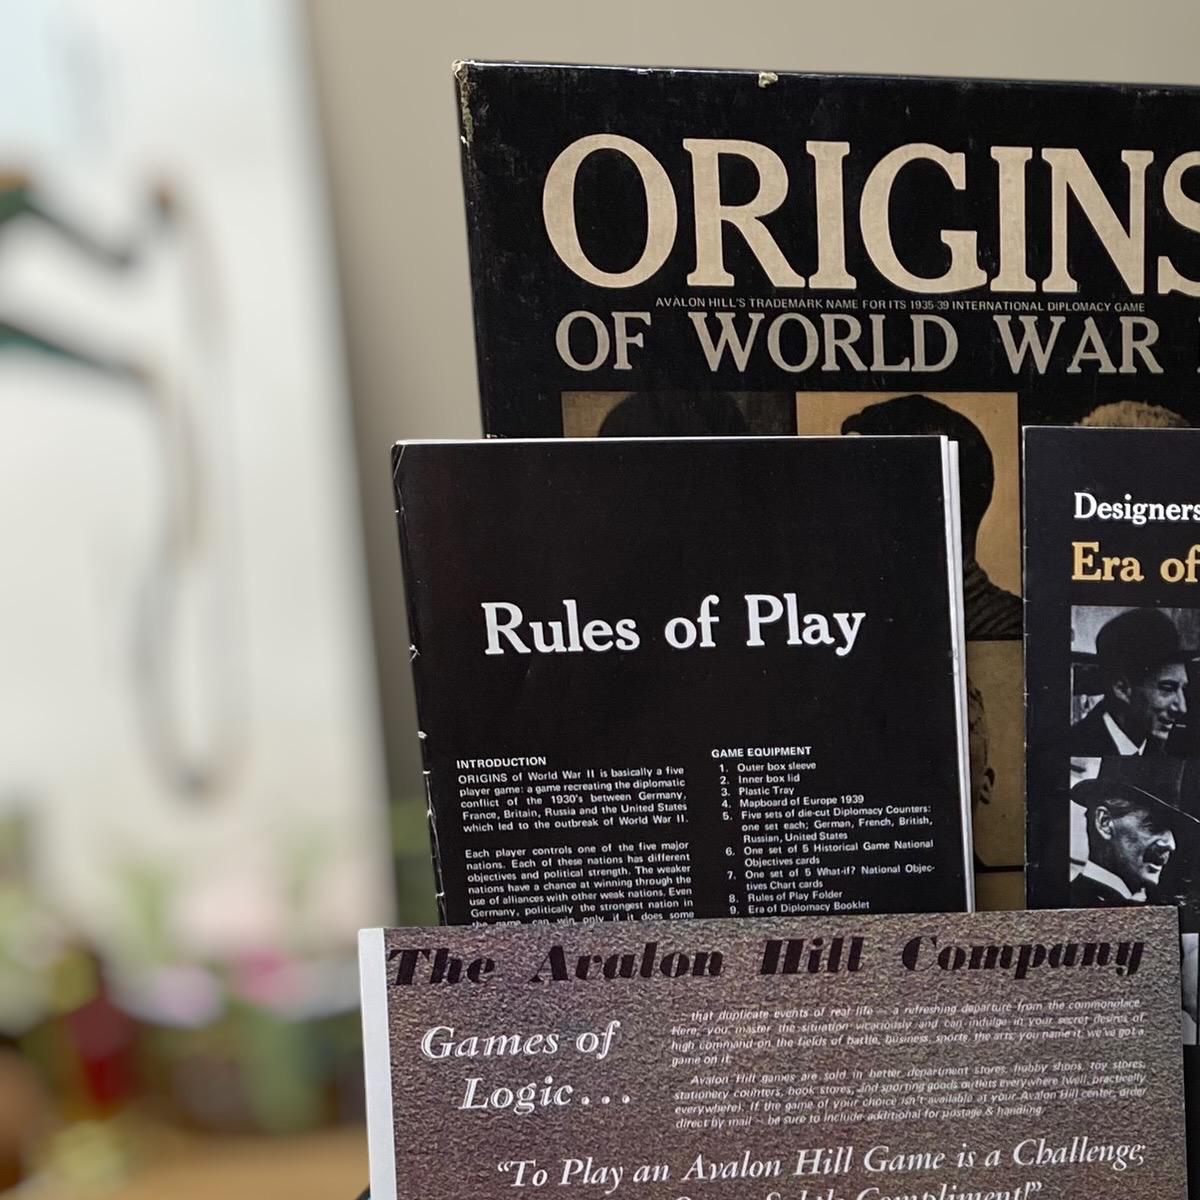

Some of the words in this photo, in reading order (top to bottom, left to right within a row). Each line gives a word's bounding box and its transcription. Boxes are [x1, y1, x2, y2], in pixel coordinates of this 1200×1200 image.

[655, 297, 705, 307] AVALON
[708, 298, 746, 307] HILL'S
[750, 298, 823, 308] TRADEMARK
[826, 299, 857, 309] NAME
[862, 299, 886, 309] FOR
[888, 300, 906, 309] ITS
[910, 300, 949, 310] 1935-39
[952, 300, 1044, 311] INTERNATIONAL
[1047, 301, 1111, 311] DIPLOMACY
[1114, 302, 1144, 312] GAME
[555, 310, 651, 371] OF
[687, 311, 958, 372] WORLD
[992, 314, 1164, 374] WAR
[1071, 541, 1144, 582] Era
[480, 599, 640, 655] Rules
[664, 594, 719, 649] of
[744, 592, 866, 656] Play
[456, 756, 546, 768] INTRODUCTION
[711, 748, 743, 758] GAME
[747, 746, 811, 756] EQUIPMENT
[719, 763, 728, 772] 1.
[737, 763, 764, 772] Outer
[767, 762, 786, 771] box
[788, 761, 816, 770] sleeve
[719, 775, 729, 785] 2.
[738, 775, 763, 784] Inner
[765, 774, 785, 783] box
[787, 773, 800, 782] lid
[721, 799, 731, 808] 4.
[739, 797, 788, 808] Mapboard
[789, 796, 800, 806] of
[803, 796, 837, 806] Europe
[840, 794, 864, 804] 1939
[388, 949, 495, 986] The
[529, 942, 724, 982] Avalon
[760, 936, 864, 975] Hill
[902, 935, 1146, 980] Company
[420, 1025, 559, 1058] Games
[575, 1020, 621, 1059] of
[558, 1156, 623, 1194] Play
[632, 1164, 669, 1182] an
[681, 1150, 780, 1180] Avalon
[792, 1146, 853, 1175] Hill
[863, 1145, 945, 1172] Game
[957, 1143, 973, 1168] is
[984, 1150, 1000, 1167] a
